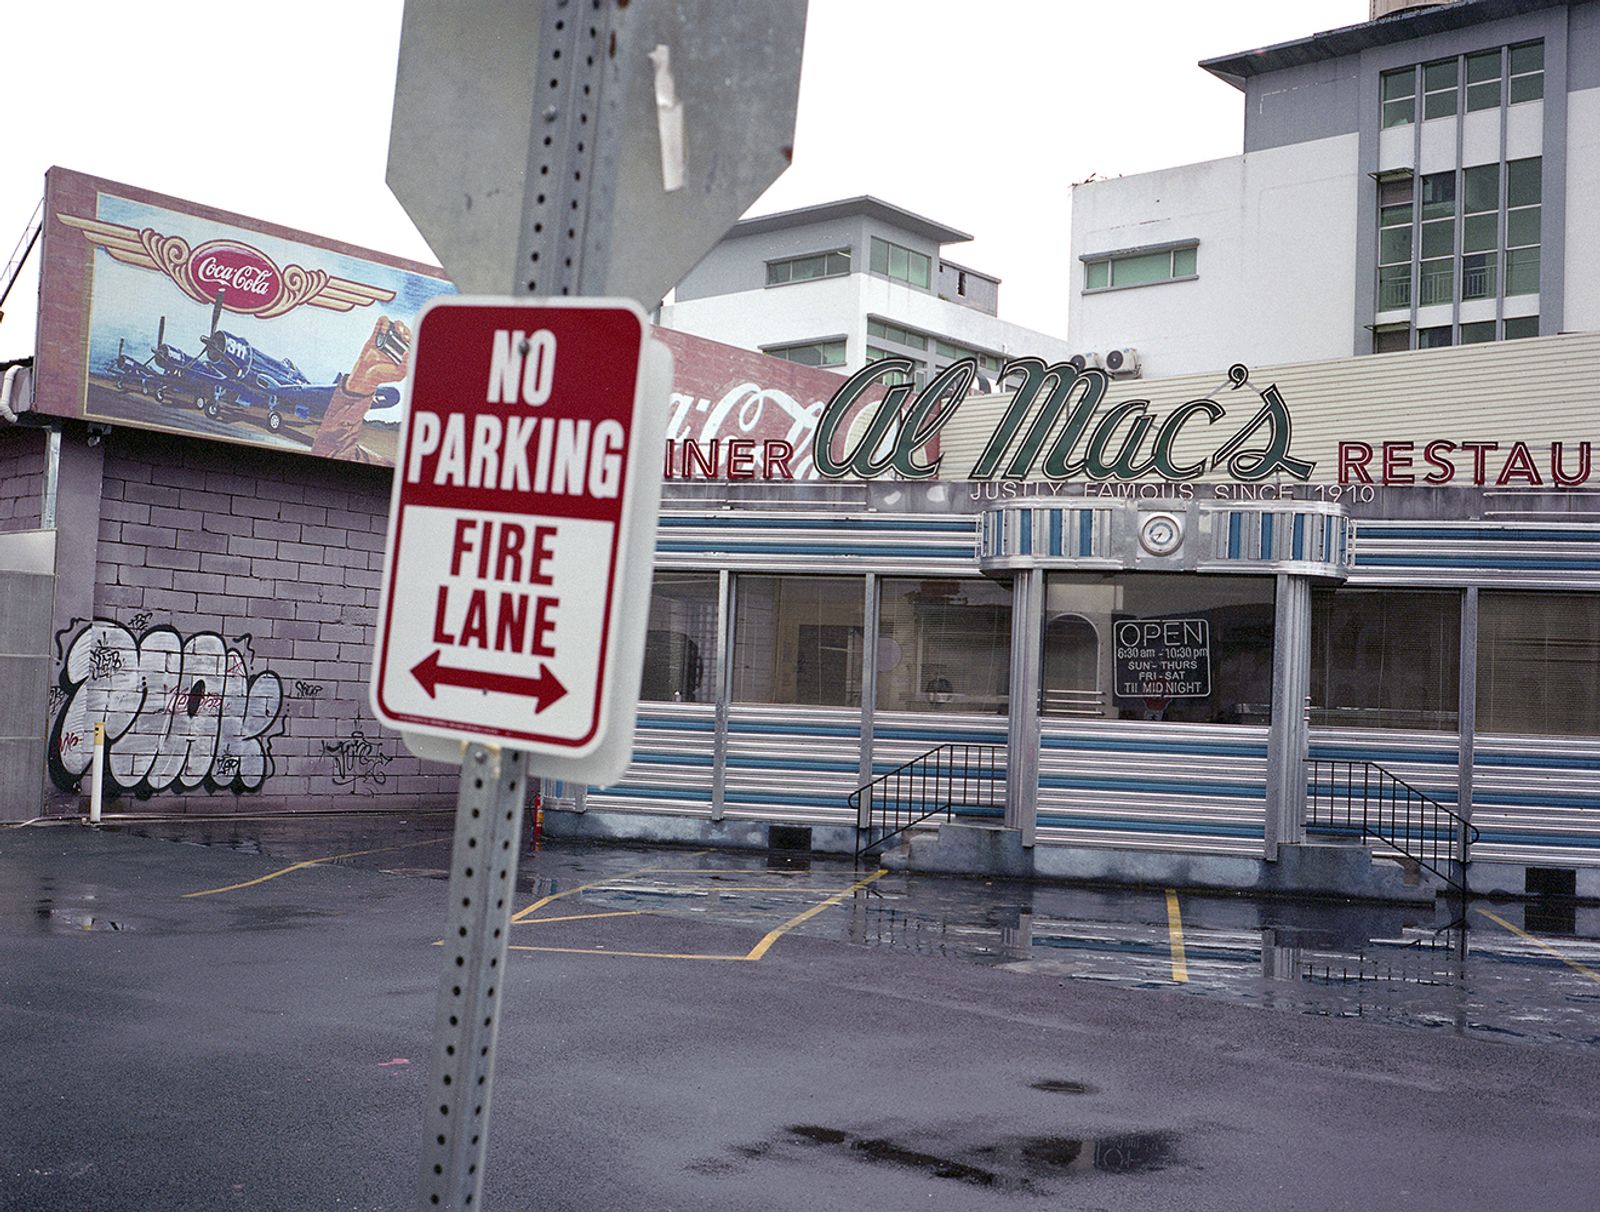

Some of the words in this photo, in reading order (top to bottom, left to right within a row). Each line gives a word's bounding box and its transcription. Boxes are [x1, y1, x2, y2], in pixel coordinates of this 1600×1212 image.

[198, 257, 273, 295] Coca-Cola
[486, 329, 557, 407] NO
[812, 356, 977, 480] Al
[968, 356, 1316, 481] Mac's
[407, 411, 625, 500] PARKING
[1337, 440, 1592, 487] RESTAU
[1084, 481, 1195, 500] FAMOUS
[1214, 483, 1295, 500] SINCE
[1314, 483, 1375, 503] 1910
[450, 519, 558, 586] FIRE
[433, 585, 560, 658] LANE
[1120, 622, 1202, 647] OPEN
[1162, 660, 1198, 669] THURS
